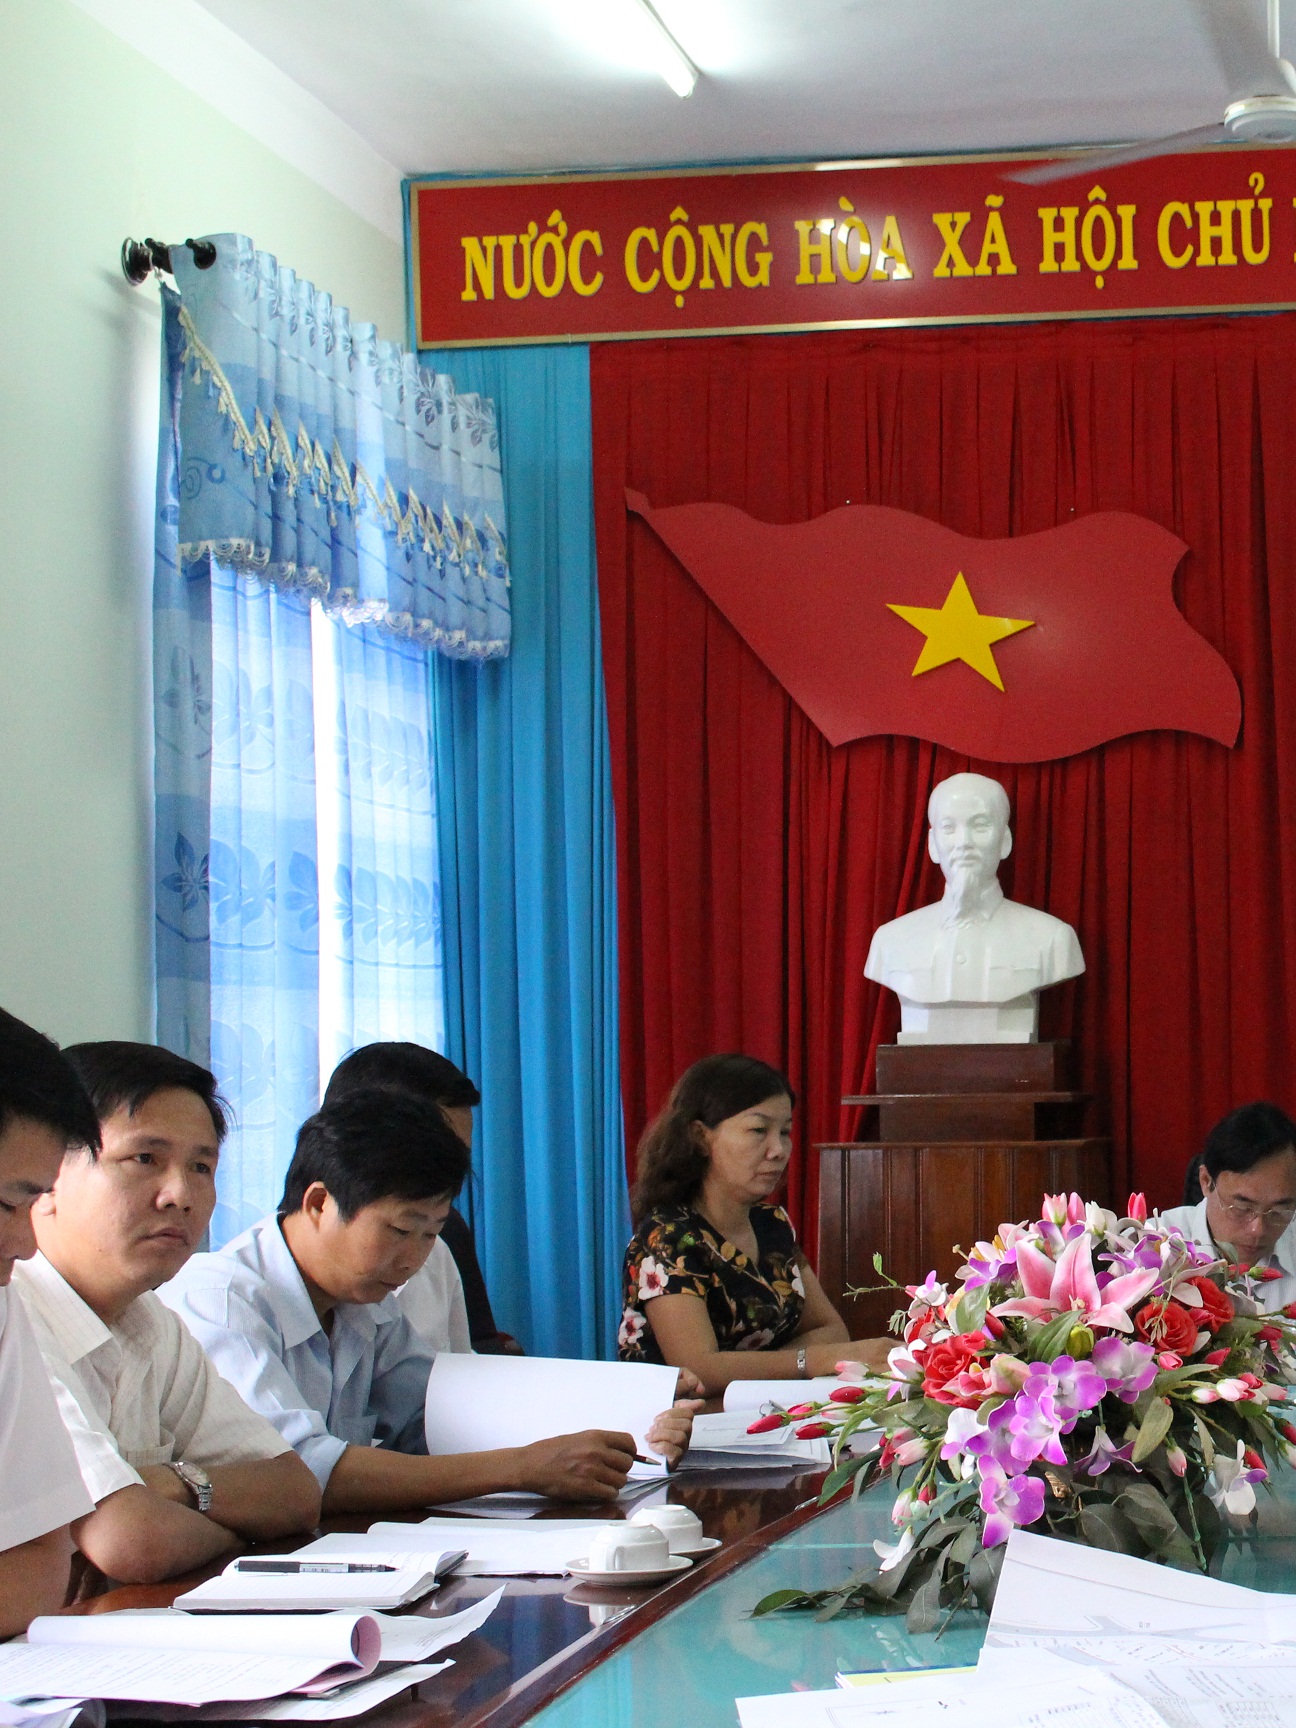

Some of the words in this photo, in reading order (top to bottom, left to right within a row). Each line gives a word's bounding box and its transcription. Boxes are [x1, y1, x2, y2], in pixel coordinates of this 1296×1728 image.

[461, 209, 604, 301] NƯỚC
[624, 206, 774, 308] CỘNG
[794, 196, 913, 285] HÒA
[932, 194, 1017, 278] XÃ
[1038, 185, 1138, 289] HỘI
[1157, 172, 1273, 269] CHỦ
